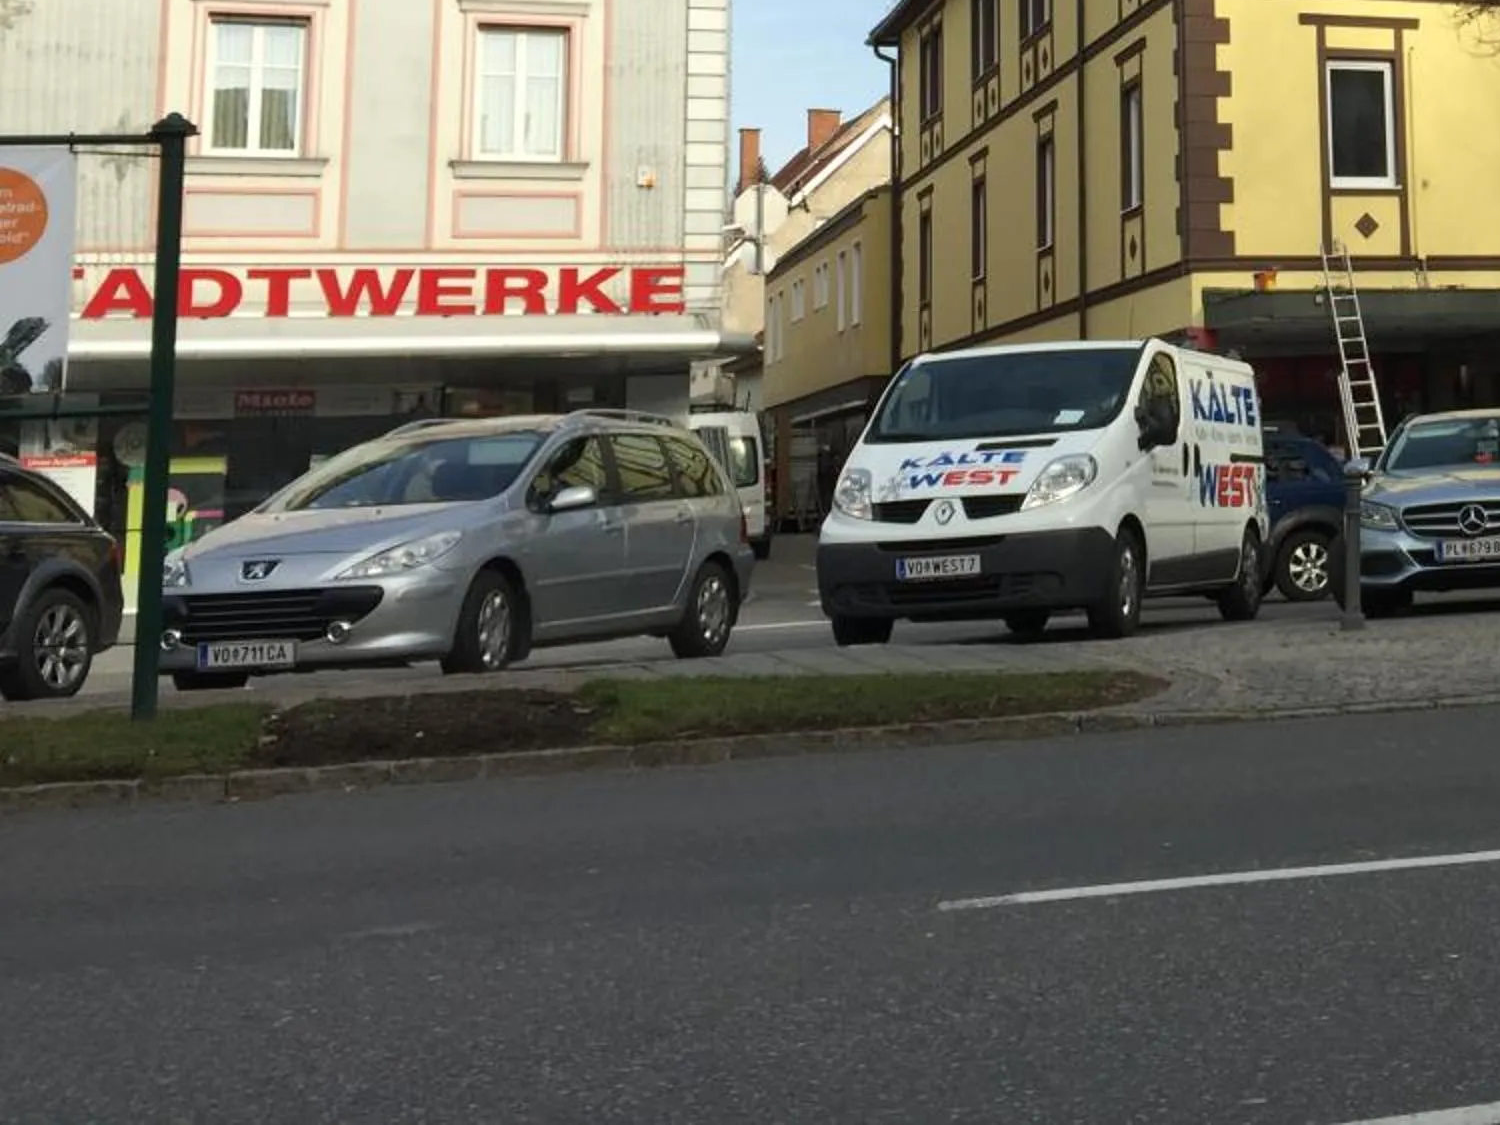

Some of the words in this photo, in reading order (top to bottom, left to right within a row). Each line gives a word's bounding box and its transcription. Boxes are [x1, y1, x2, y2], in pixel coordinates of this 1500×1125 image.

[72, 267, 685, 318] ADTWERKE
[910, 470, 1020, 488] WEST
[1199, 464, 1254, 507] WEST
